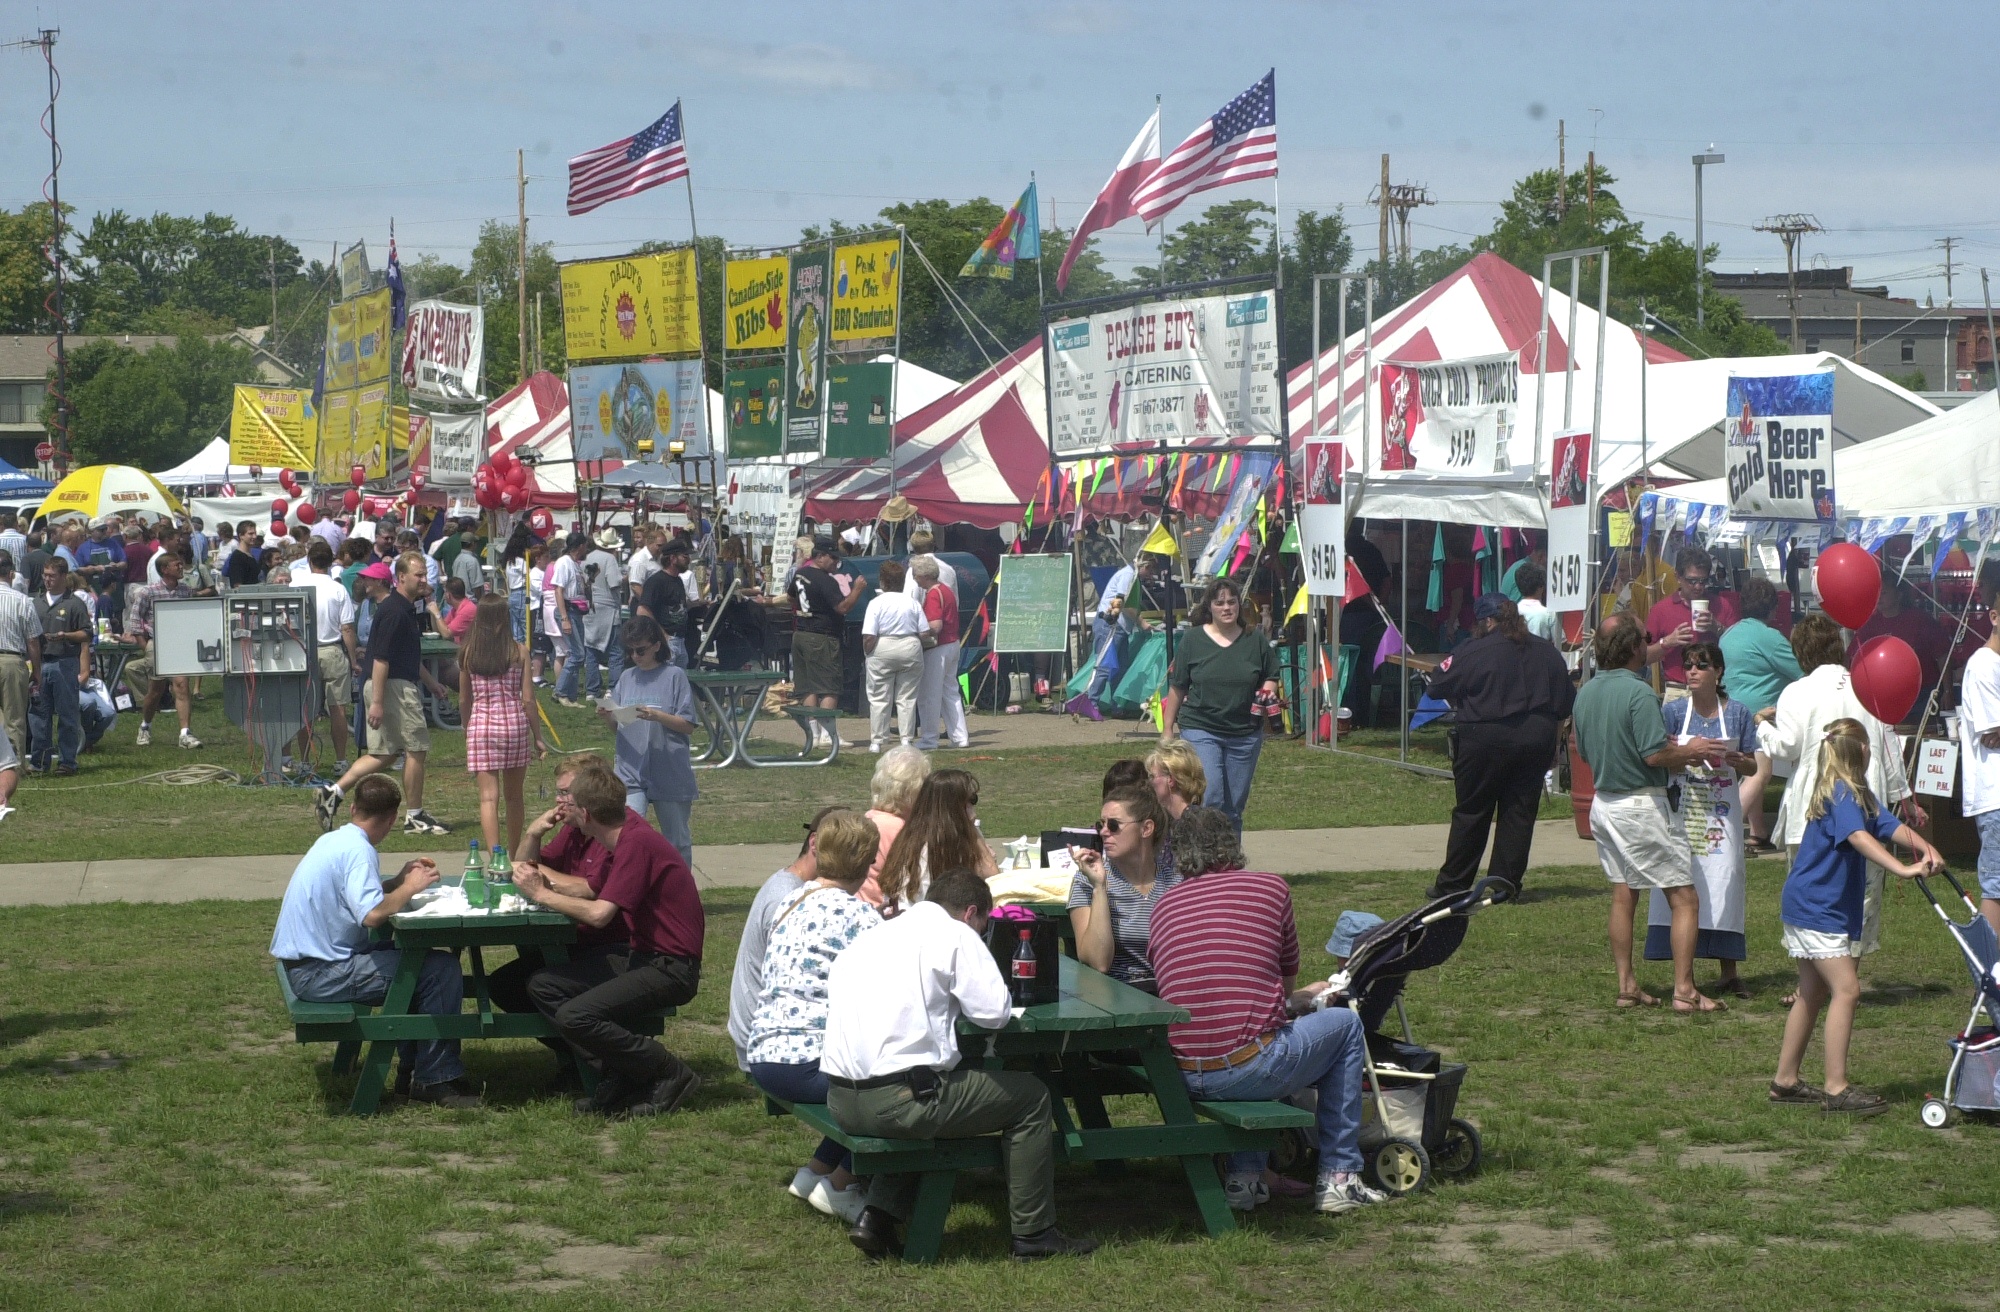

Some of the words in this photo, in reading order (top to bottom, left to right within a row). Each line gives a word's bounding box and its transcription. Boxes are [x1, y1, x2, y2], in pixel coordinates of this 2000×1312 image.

[609, 261, 642, 294] DADDY'S
[855, 253, 876, 275] Pork
[728, 267, 784, 309] Canadian-Side
[850, 286, 859, 300] or
[862, 278, 880, 299] Chix
[735, 307, 766, 345] Ribs
[834, 307, 850, 332] BBQ
[853, 304, 894, 330] Sandwich
[1105, 315, 1156, 361] POLISH
[1164, 311, 1196, 350] ED'S
[1125, 365, 1191, 386] CATERING
[1444, 366, 1470, 407] COLA
[1474, 360, 1518, 406] PRODUCTS
[36, 448, 50, 456] STOP
[1766, 420, 1824, 460] Beer
[1728, 440, 1764, 505] Cold
[1768, 462, 1826, 500] Here
[1312, 543, 1336, 581] $1.50
[1552, 554, 1581, 598] $1.50
[1927, 764, 1944, 774] CALL
[1929, 748, 1948, 758] LAST
